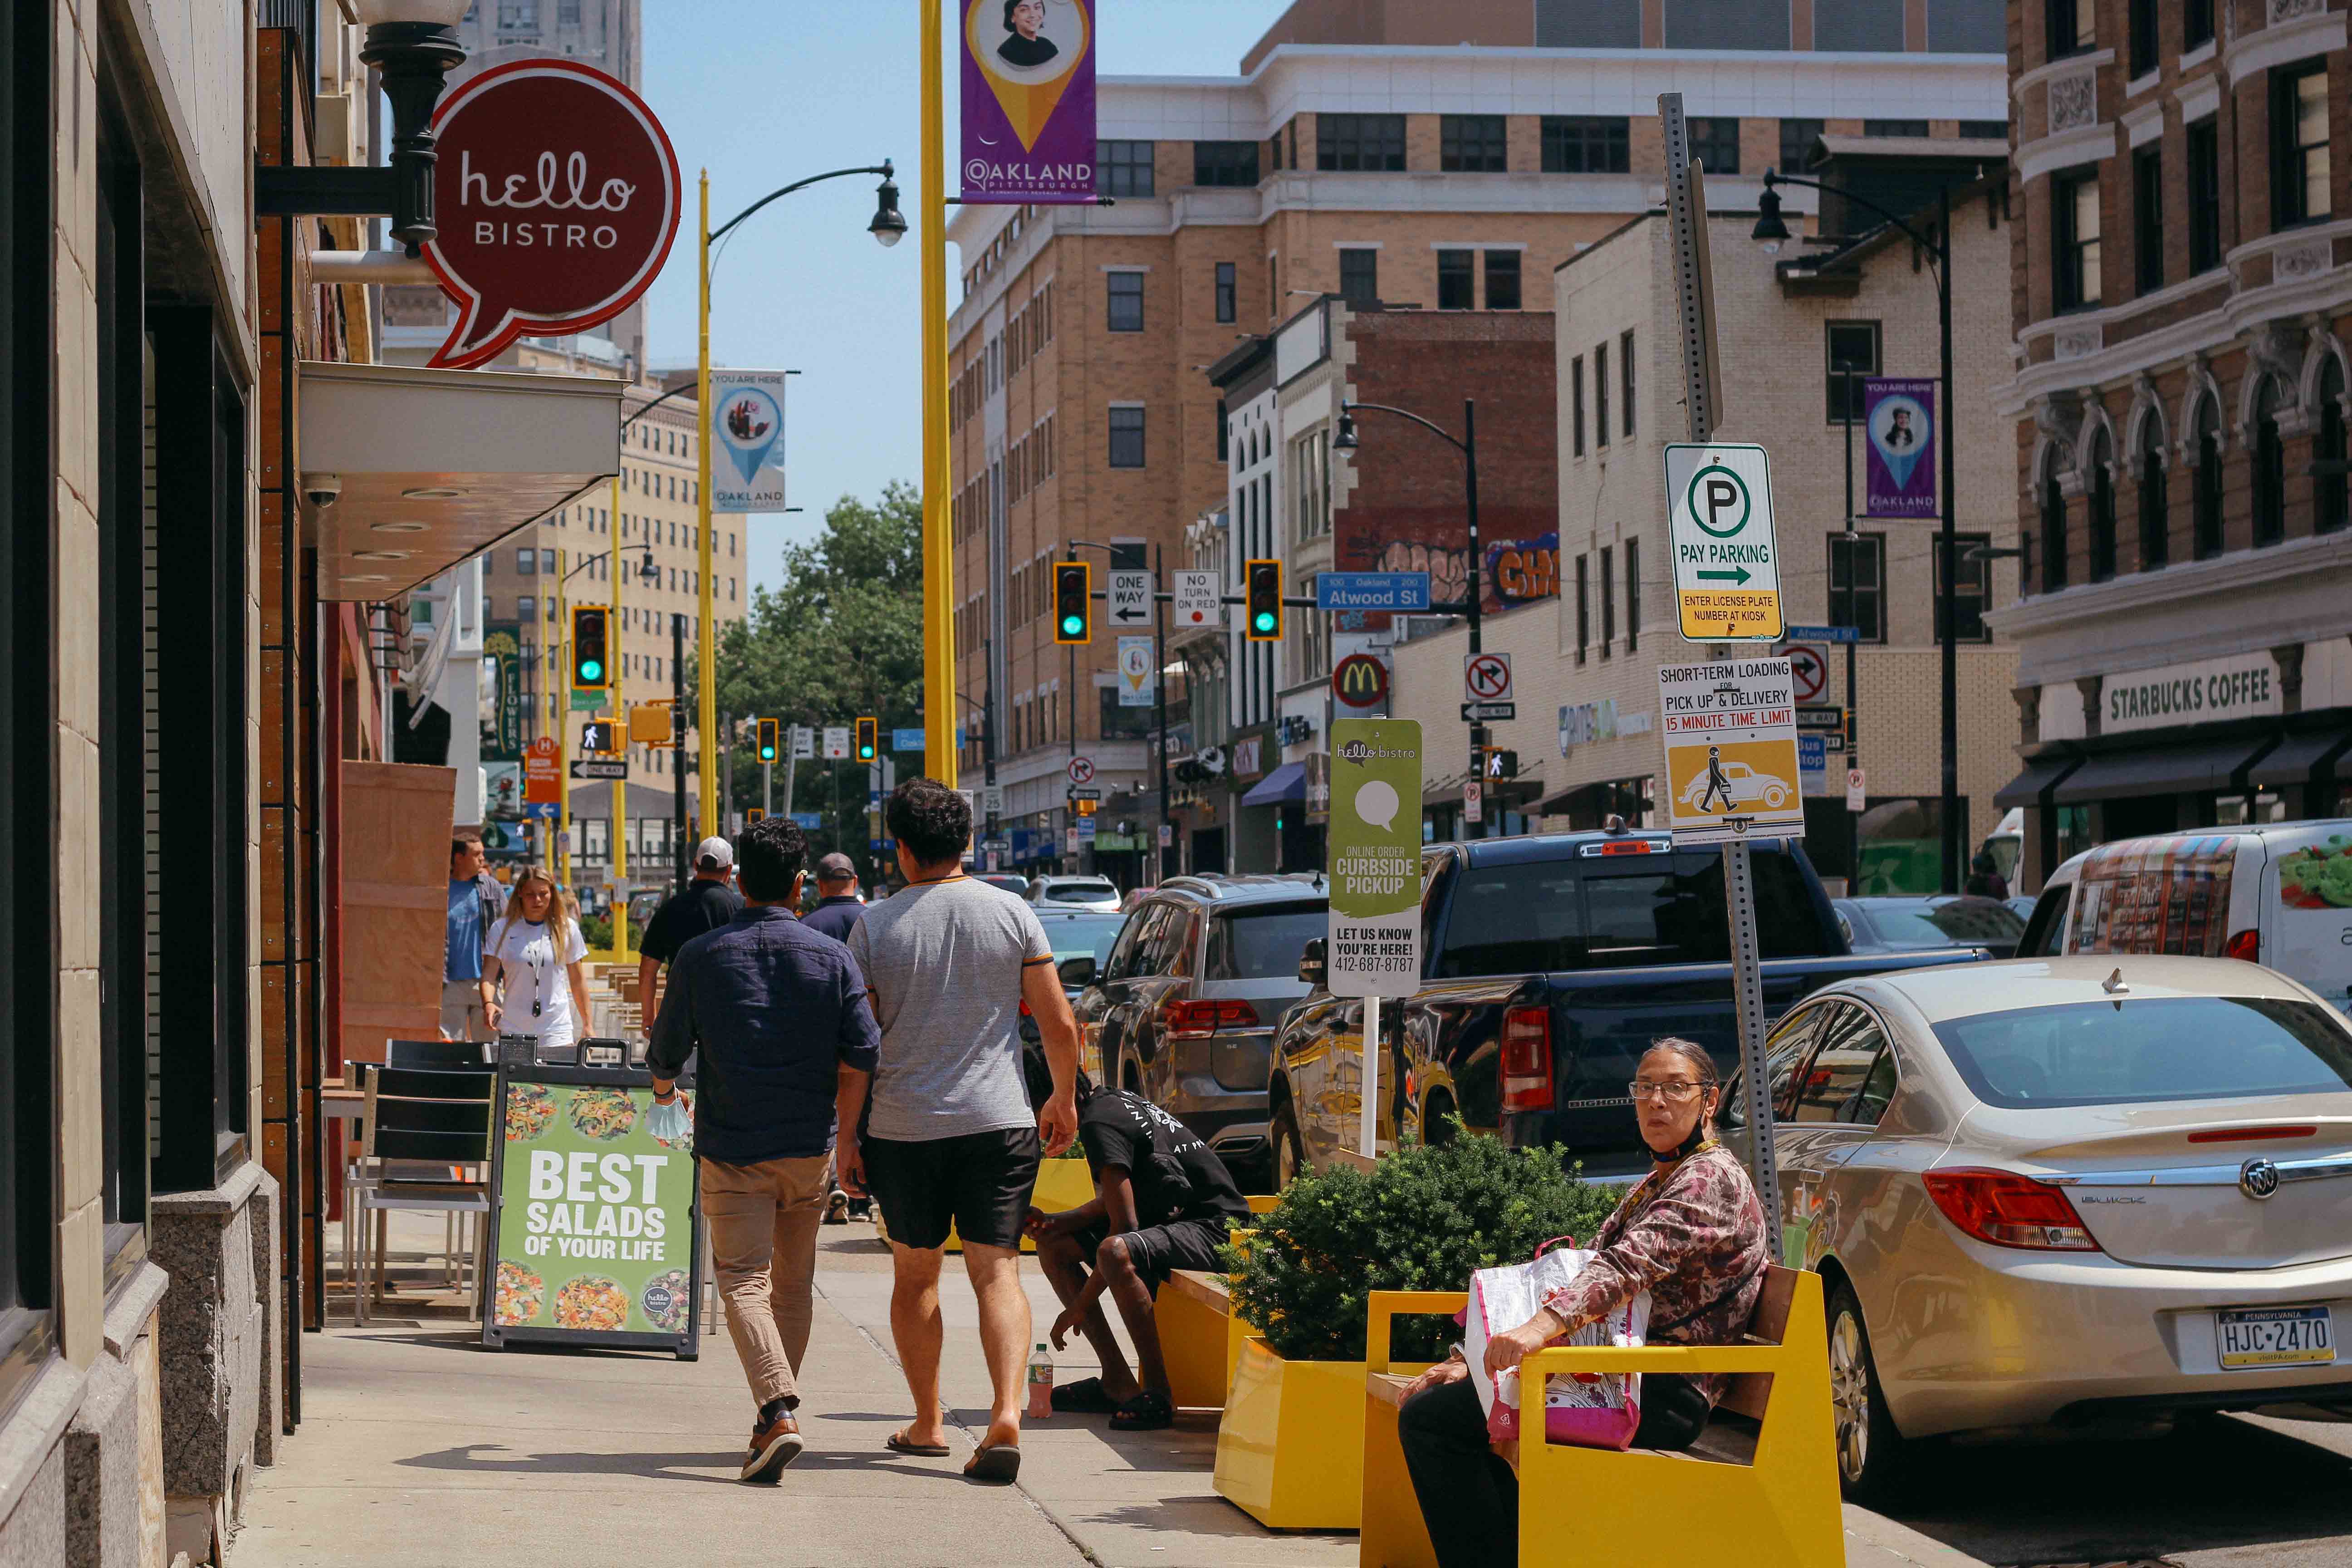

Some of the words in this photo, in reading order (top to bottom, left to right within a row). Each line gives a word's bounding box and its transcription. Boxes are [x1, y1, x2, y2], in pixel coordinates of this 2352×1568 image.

[968, 162, 1091, 181] OAKLAND
[461, 150, 636, 212] hello
[475, 221, 617, 249] BISTRO
[758, 376, 782, 384] HERE
[716, 491, 782, 501] OAKLAND
[1706, 480, 1737, 524] P
[1870, 496, 1934, 507] OAKLAND
[1681, 544, 1705, 563] PAY
[1710, 544, 1769, 564] PARKING
[1116, 577, 1144, 588] ONE
[1187, 575, 1206, 586] NO
[1115, 591, 1145, 604] WAY
[1185, 588, 1210, 597] TURN
[1329, 590, 1394, 604] Atwood
[1401, 590, 1418, 604] St
[1178, 600, 1191, 608] ON
[1197, 600, 1215, 608] RED
[1685, 596, 1711, 606] ENTER
[1713, 596, 1746, 607] LICENSE
[1749, 596, 1773, 607] PLATE
[1695, 610, 1728, 621] NUMBER
[1730, 611, 1739, 621] AT
[1741, 611, 1766, 621] KIOSK
[1797, 628, 1838, 638] Atwood
[1842, 628, 1853, 639] St
[1661, 665, 1734, 683] SHORT-TERM
[1739, 662, 1789, 678] LOADING
[1666, 696, 1693, 710] PICK
[1698, 695, 1714, 708] UP
[1719, 694, 1727, 706] &
[1731, 689, 1788, 706] DELIVERY
[2111, 677, 2202, 720] STARBUCKS
[2208, 668, 2270, 708] COFFEE
[507, 673, 518, 750] FLOWERS
[1477, 707, 1490, 715] ONE
[1495, 706, 1509, 715] WAY
[1817, 712, 1834, 722] WAY
[1666, 717, 1677, 730] 15
[1682, 714, 1725, 730] MINUTE
[1730, 712, 1757, 726] TIME
[1761, 710, 1791, 725] LIMIT
[1337, 743, 1377, 759] hello
[1379, 745, 1416, 759] bistro
[1346, 846, 1376, 857] ONLINE
[1378, 846, 1405, 857] ORDER
[1336, 858, 1414, 876] CURBSIDE
[1346, 877, 1405, 894] PICKUP
[1337, 928, 1358, 941] LET
[1360, 928, 1375, 941] US
[1378, 928, 1412, 941] KNOW
[1337, 943, 1378, 956] YOU'RE
[1380, 943, 1413, 956] HERE!
[1335, 957, 1414, 972] 412-687-8787
[1174, 1143, 1187, 1153] AT
[529, 1150, 668, 1205] BEST
[2081, 1195, 2146, 1205] BUICK
[526, 1201, 666, 1238] SALADS
[524, 1235, 552, 1256] OF
[558, 1237, 616, 1259] YOUR
[621, 1240, 666, 1262] LIFE
[648, 1293, 669, 1301] hello
[2245, 1311, 2302, 1322] PENNSYLVANIA
[2258, 1353, 2299, 1362] visitPA.com
